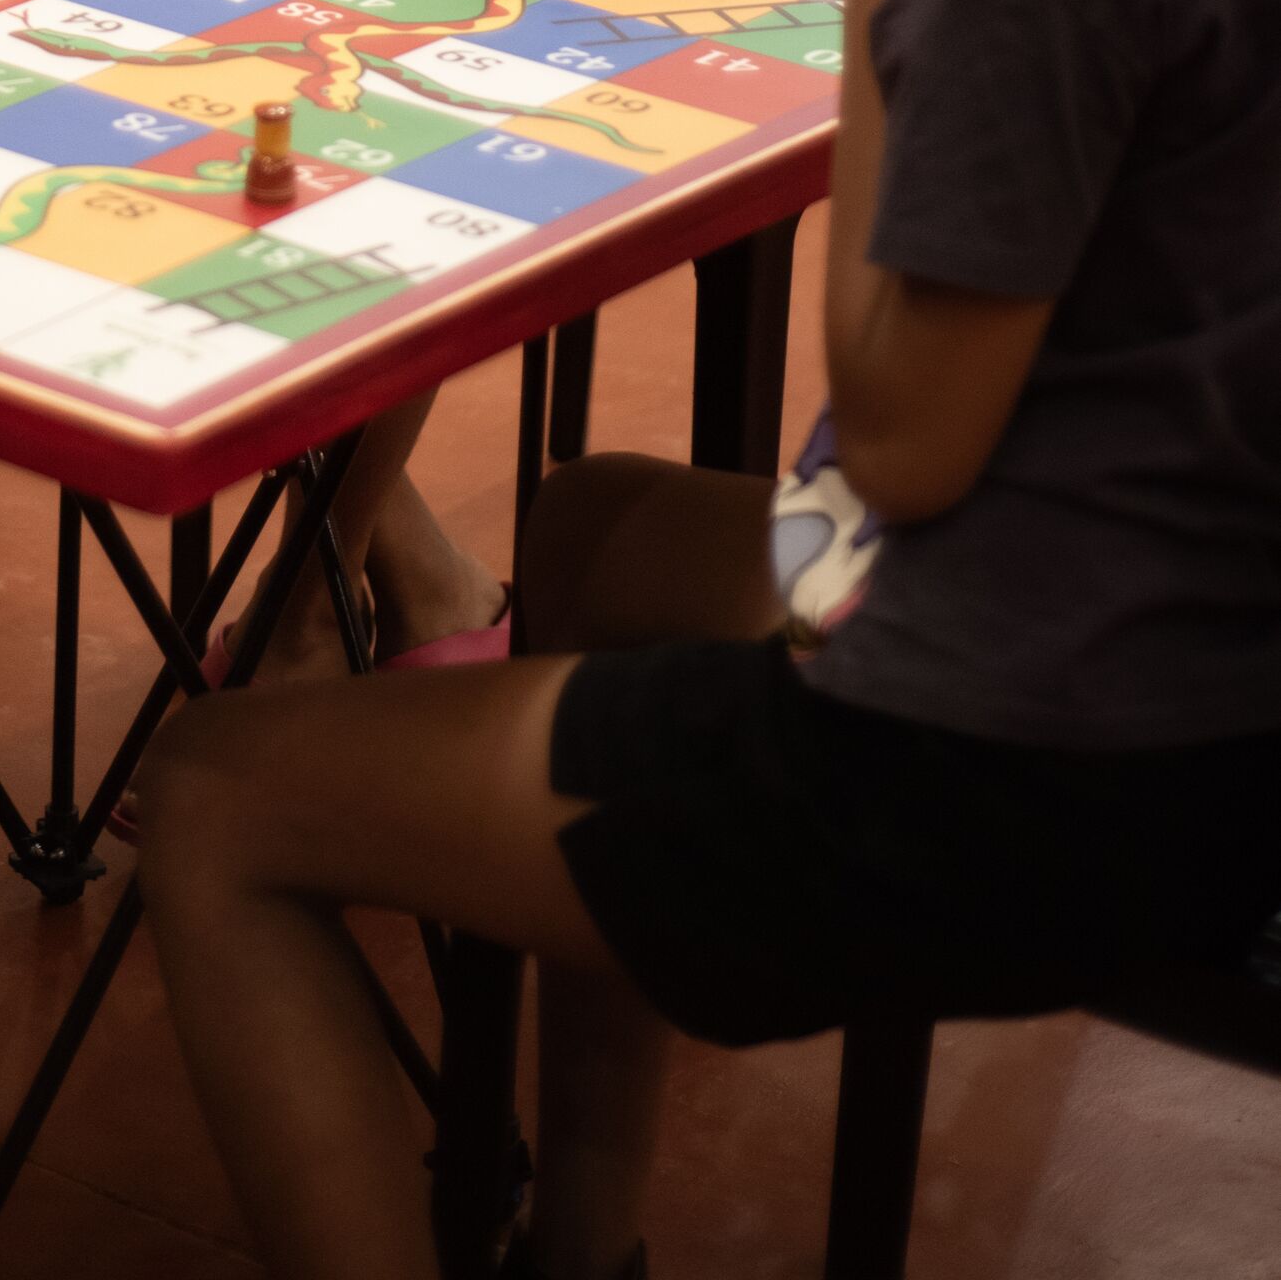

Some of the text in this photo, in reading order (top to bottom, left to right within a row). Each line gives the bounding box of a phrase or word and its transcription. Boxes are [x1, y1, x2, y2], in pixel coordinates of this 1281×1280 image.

[59, 10, 123, 33] 64
[275, 1, 342, 25] 58
[436, 49, 504, 71] 59
[545, 46, 616, 72] 42
[694, 49, 760, 74] 41
[803, 49, 842, 71] 0
[166, 94, 236, 119] 63
[586, 91, 652, 114] 60
[112, 112, 188, 142] 78
[320, 138, 394, 167] 62
[475, 134, 547, 162] 61
[82, 190, 157, 220] 82
[425, 210, 502, 241] 80
[235, 242, 307, 269] 81
